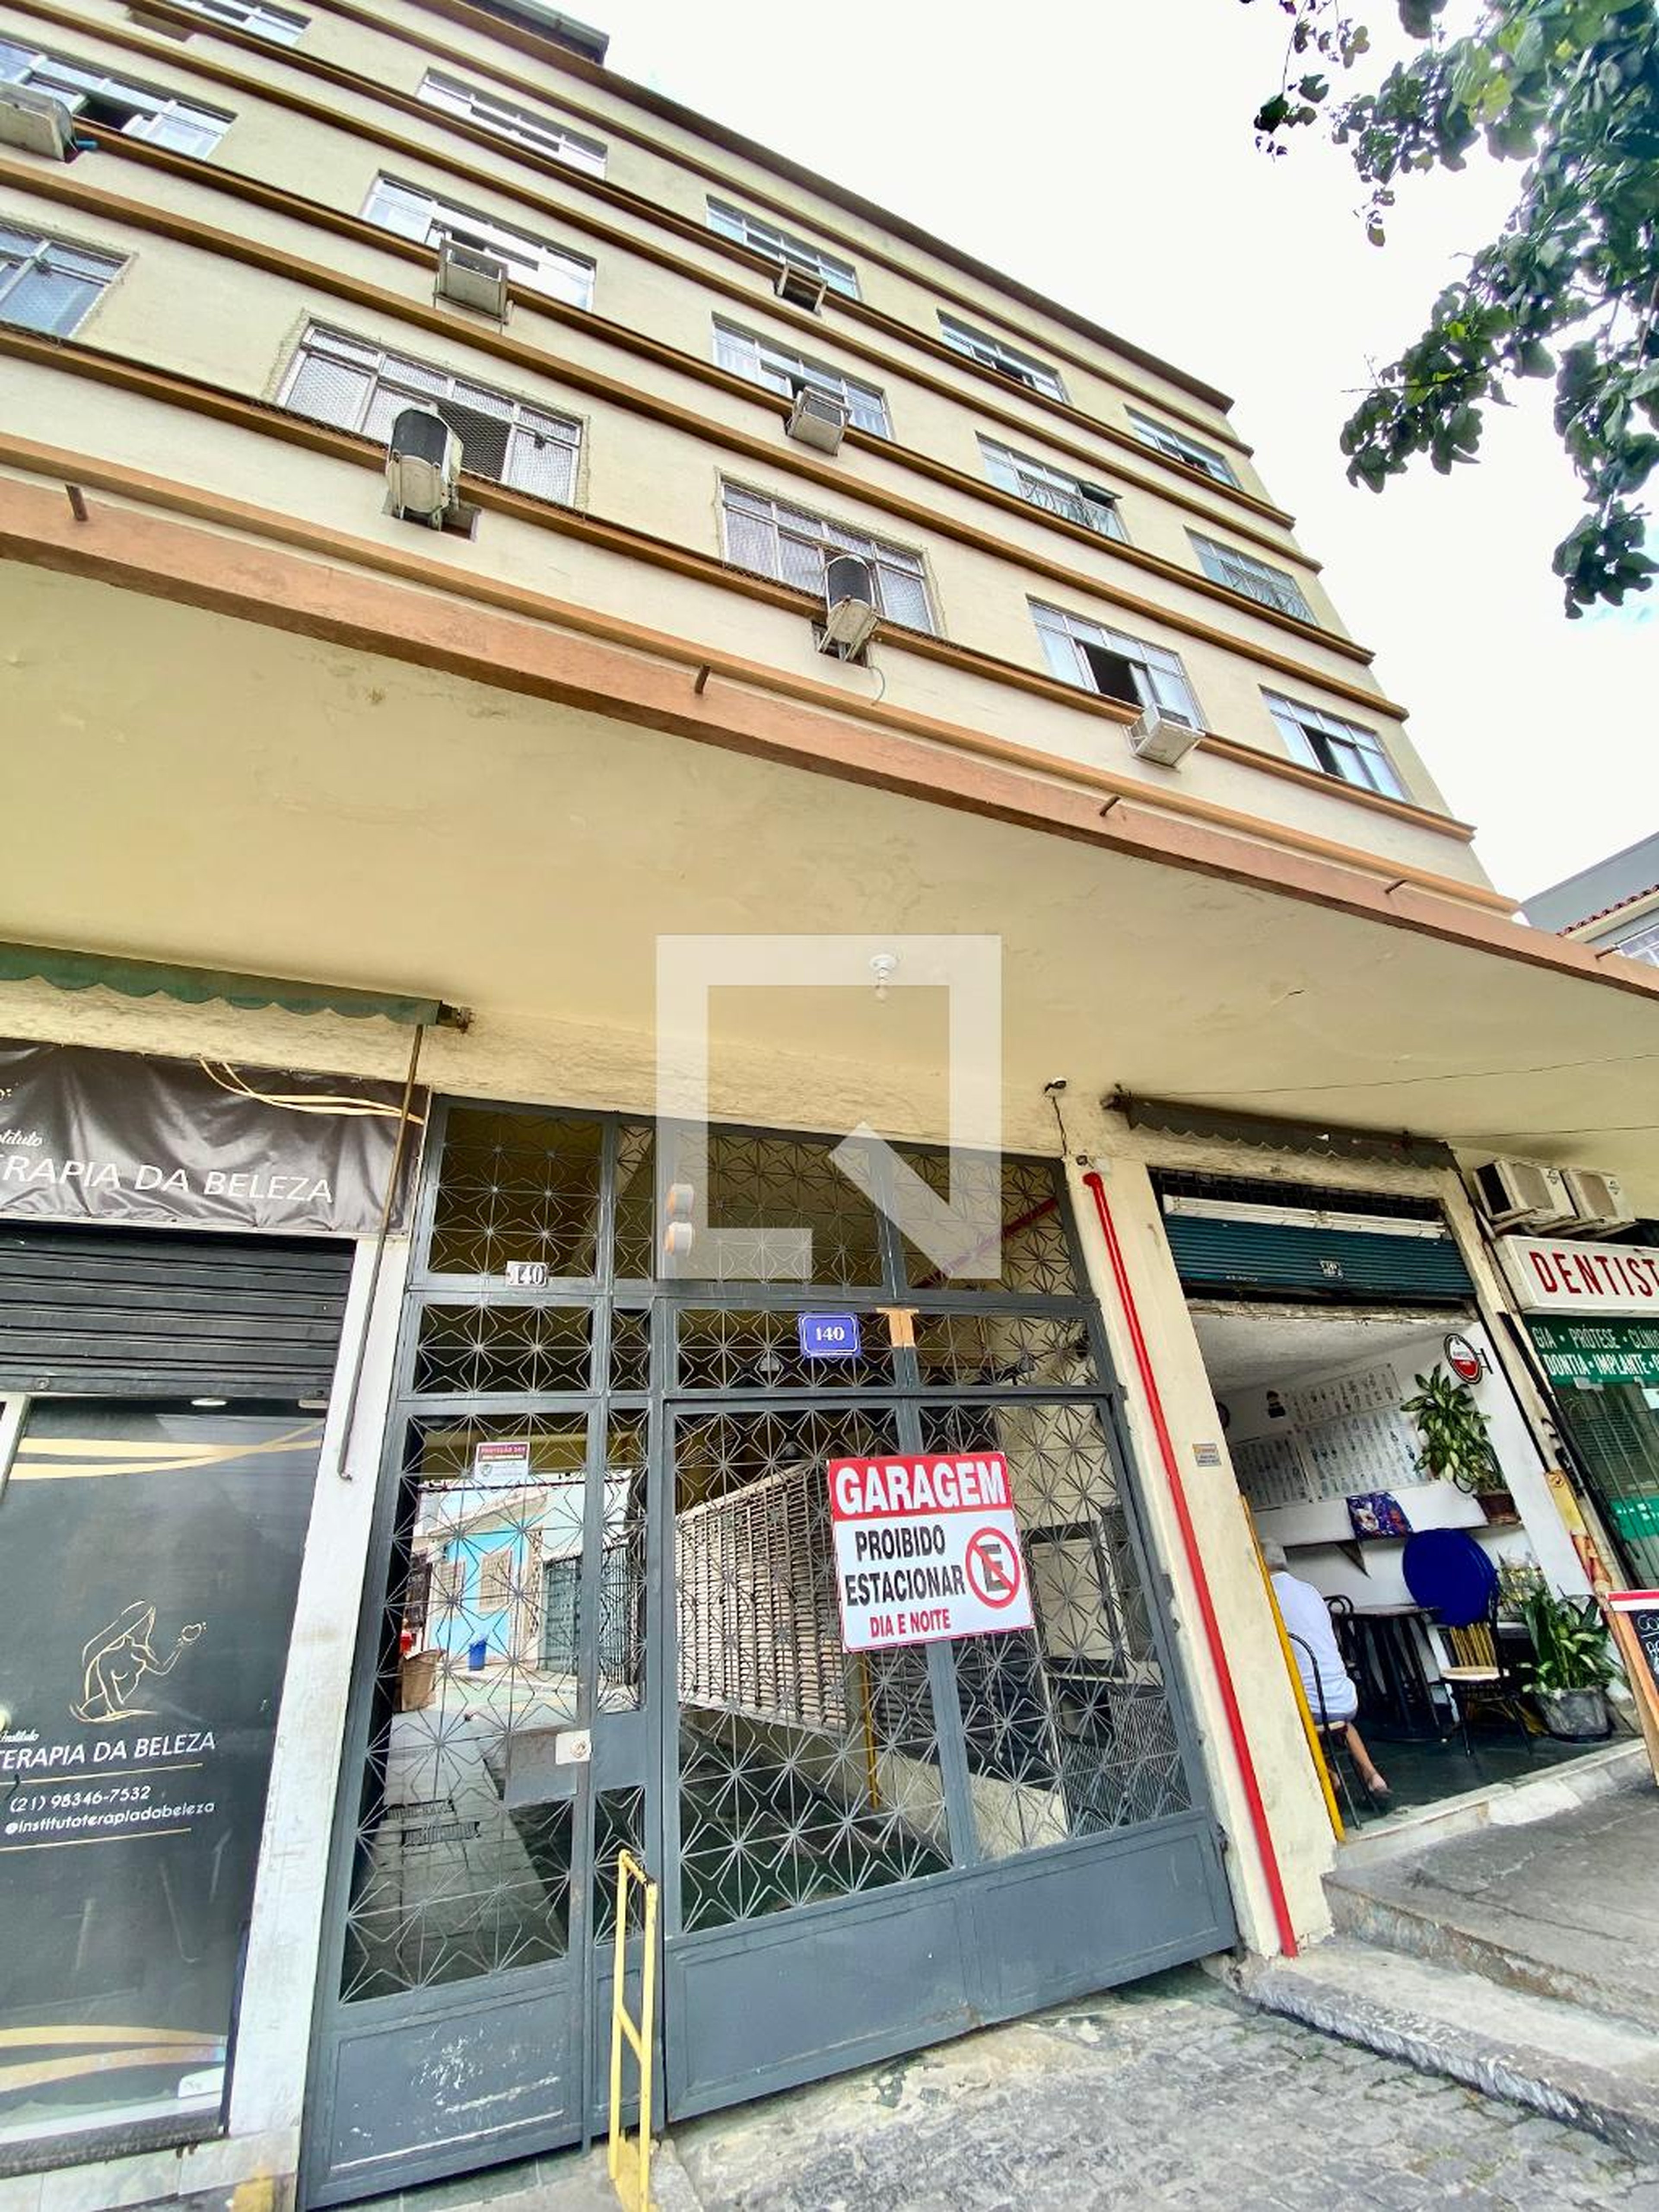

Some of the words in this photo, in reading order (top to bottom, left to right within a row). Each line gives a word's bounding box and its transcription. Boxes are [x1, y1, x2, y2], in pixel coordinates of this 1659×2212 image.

[0, 1154, 121, 1188] RAPIA
[134, 1165, 189, 1193] DA
[204, 1171, 334, 1203] BELEZA
[816, 1327, 845, 1341] 140
[1568, 1324, 1621, 1349] PRÓTESE
[1542, 1354, 1591, 1376] DONTIA
[1592, 1354, 1651, 1375] IMPLANTE
[835, 1461, 1007, 1515] GARAGEM
[855, 1525, 946, 1563] PROIBIDO
[845, 1565, 966, 1607] ESTACIONAR
[869, 1614, 895, 1638] DIA
[897, 1614, 906, 1634] E
[910, 1609, 951, 1633] NOITE
[93, 1741, 127, 1763] DA
[134, 1732, 215, 1757] BELEZA
[10, 1796, 46, 1813] (21)
[51, 1786, 151, 1809] 98346-7532
